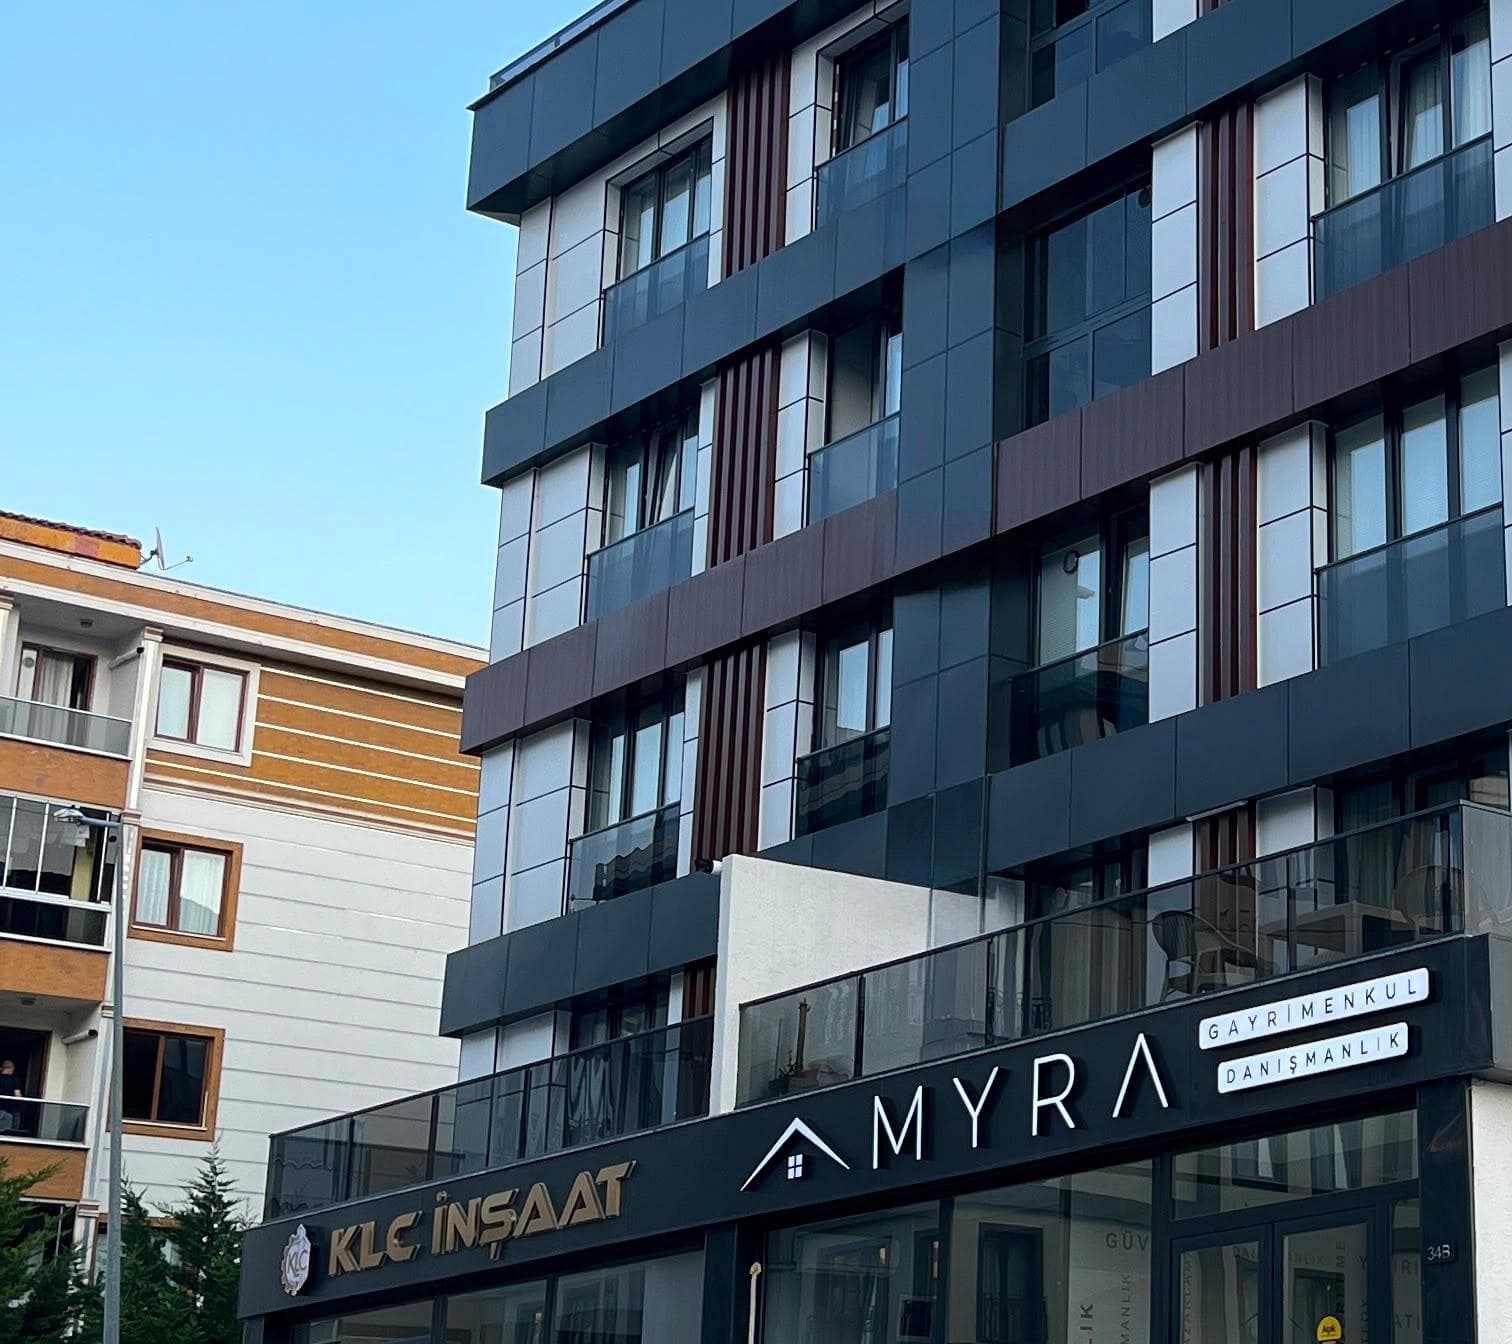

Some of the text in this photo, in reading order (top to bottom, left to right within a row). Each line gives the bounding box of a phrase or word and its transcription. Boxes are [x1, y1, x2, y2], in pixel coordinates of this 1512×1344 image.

[1226, 1031, 1400, 1084] DANIŞMANLIK
[872, 1032, 1169, 1170] MYRA
[328, 1160, 638, 1277] KLC İNŞAAT
[1105, 1230, 1149, 1252] GÜV
